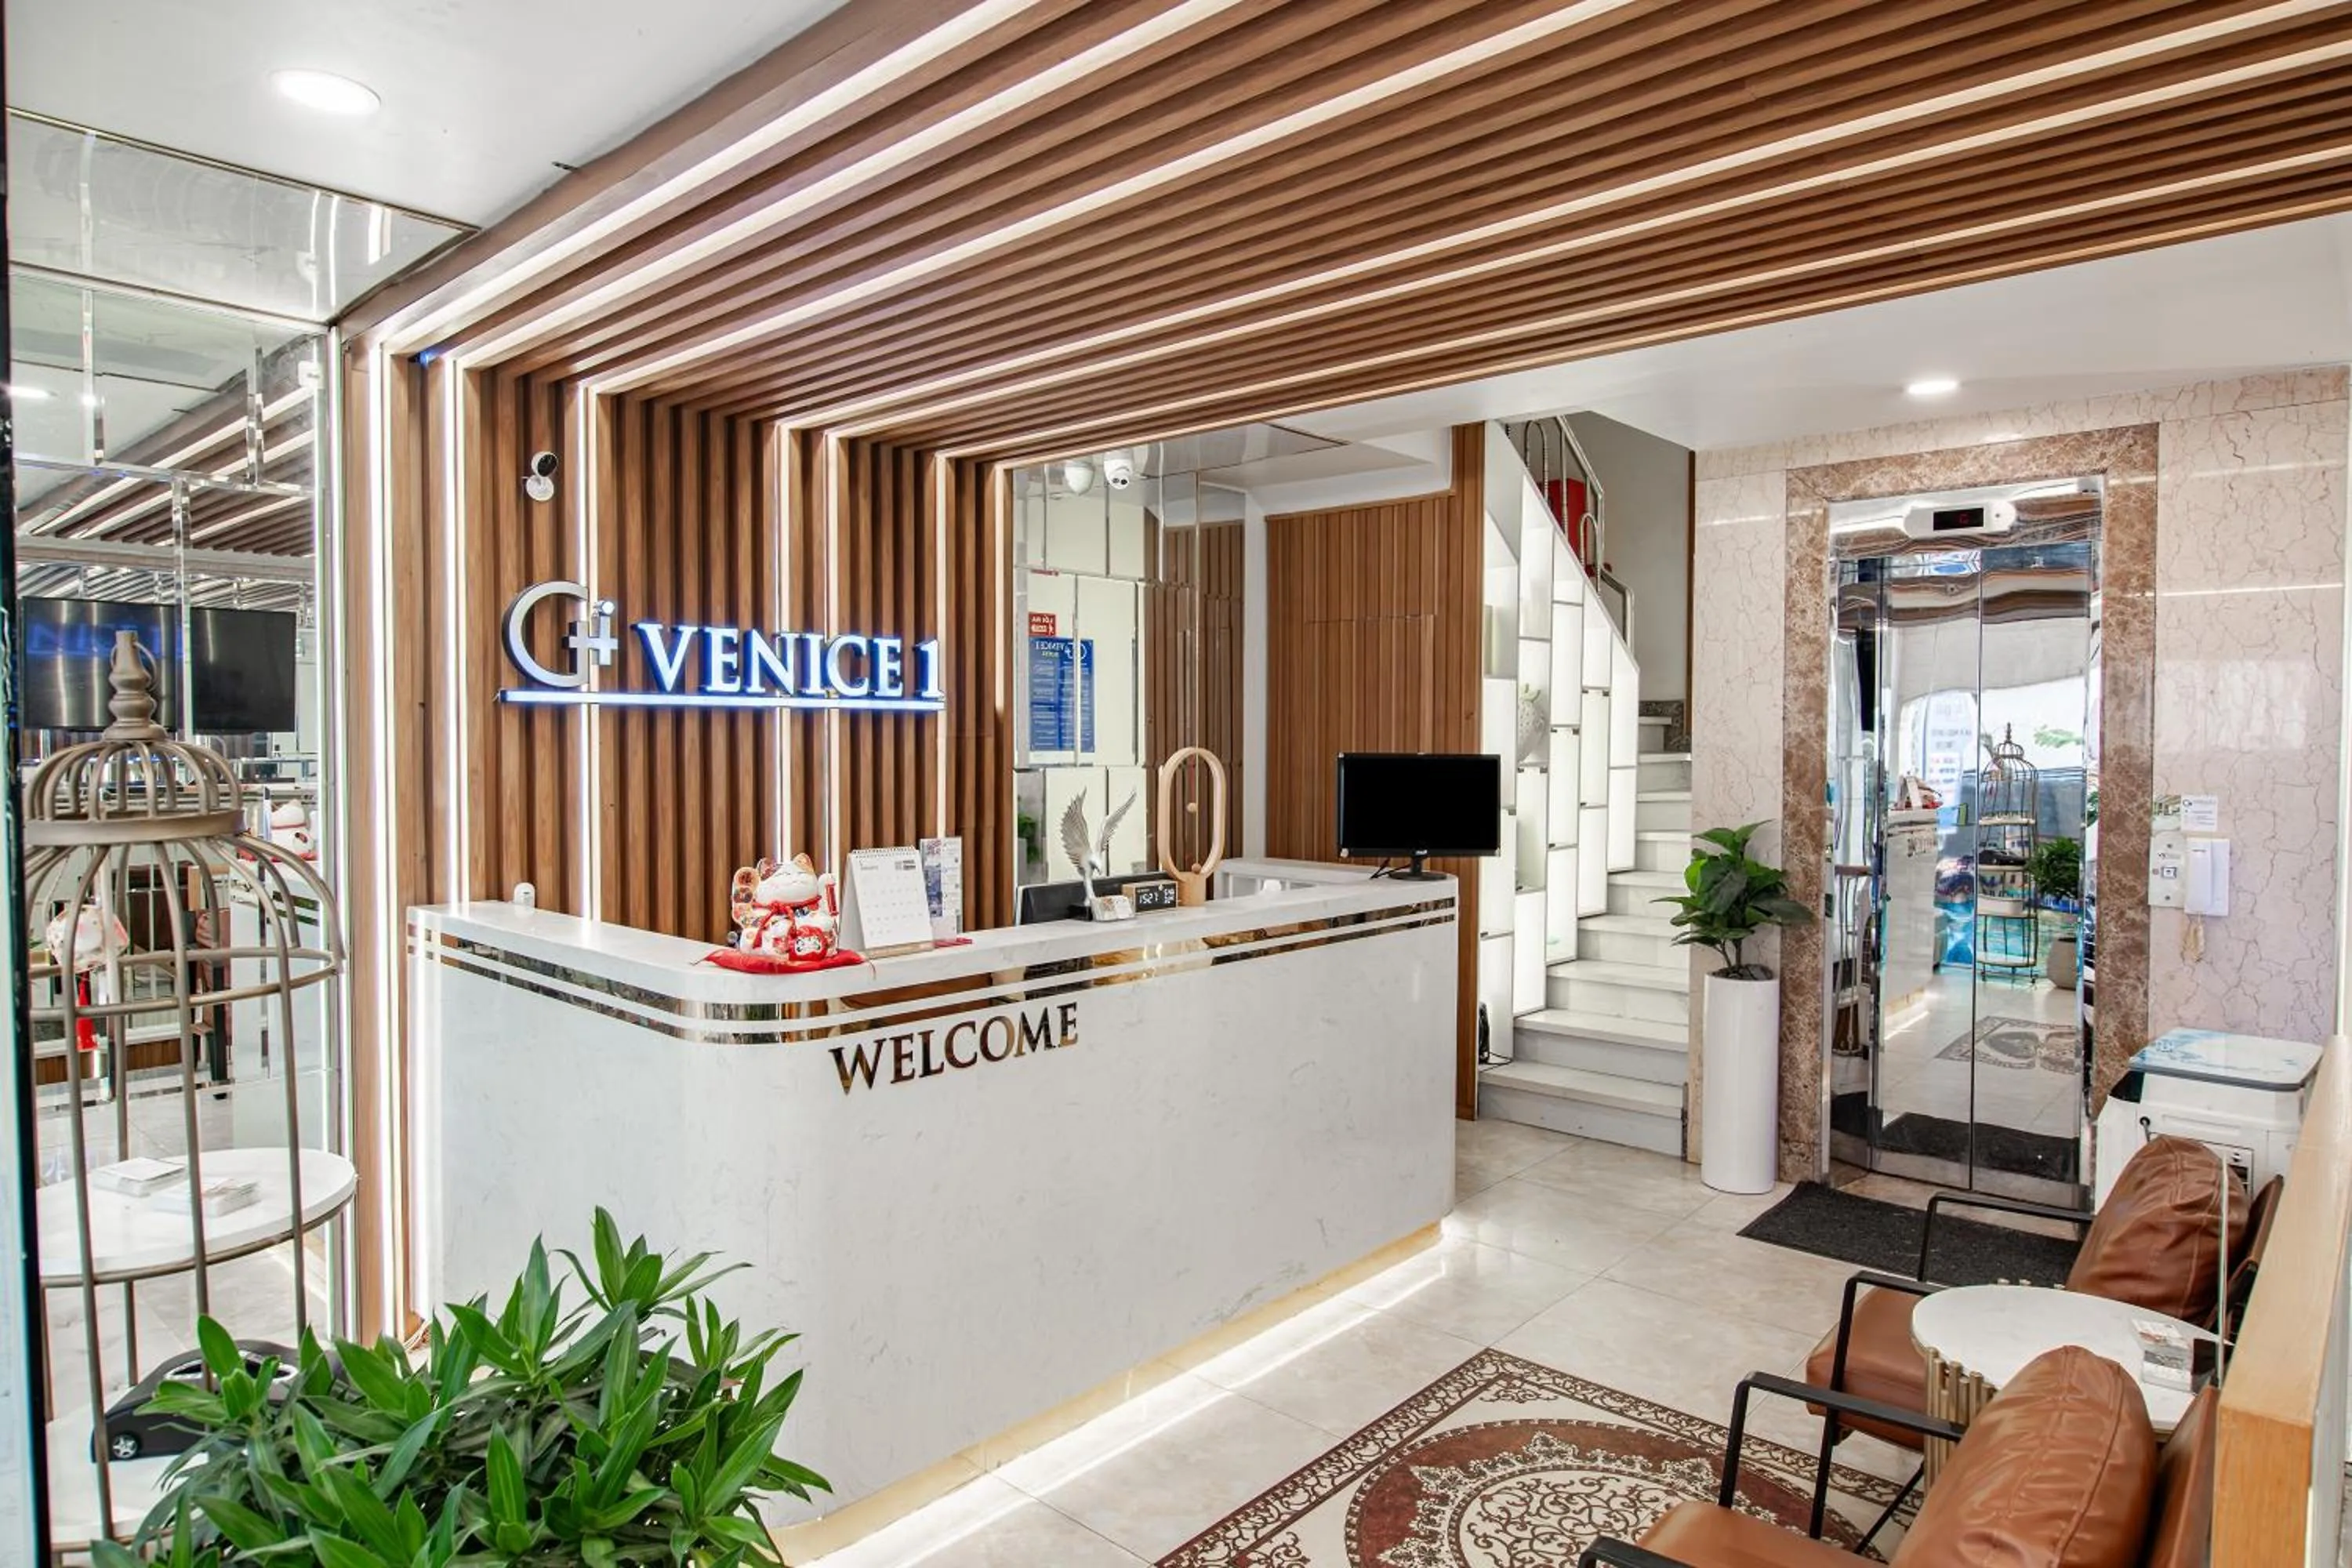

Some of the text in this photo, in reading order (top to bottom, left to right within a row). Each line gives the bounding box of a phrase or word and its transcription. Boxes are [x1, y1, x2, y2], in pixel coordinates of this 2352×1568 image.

[630, 622, 903, 697] VENICE
[914, 639, 946, 699] 1
[828, 1002, 1079, 1096] WELCOME
